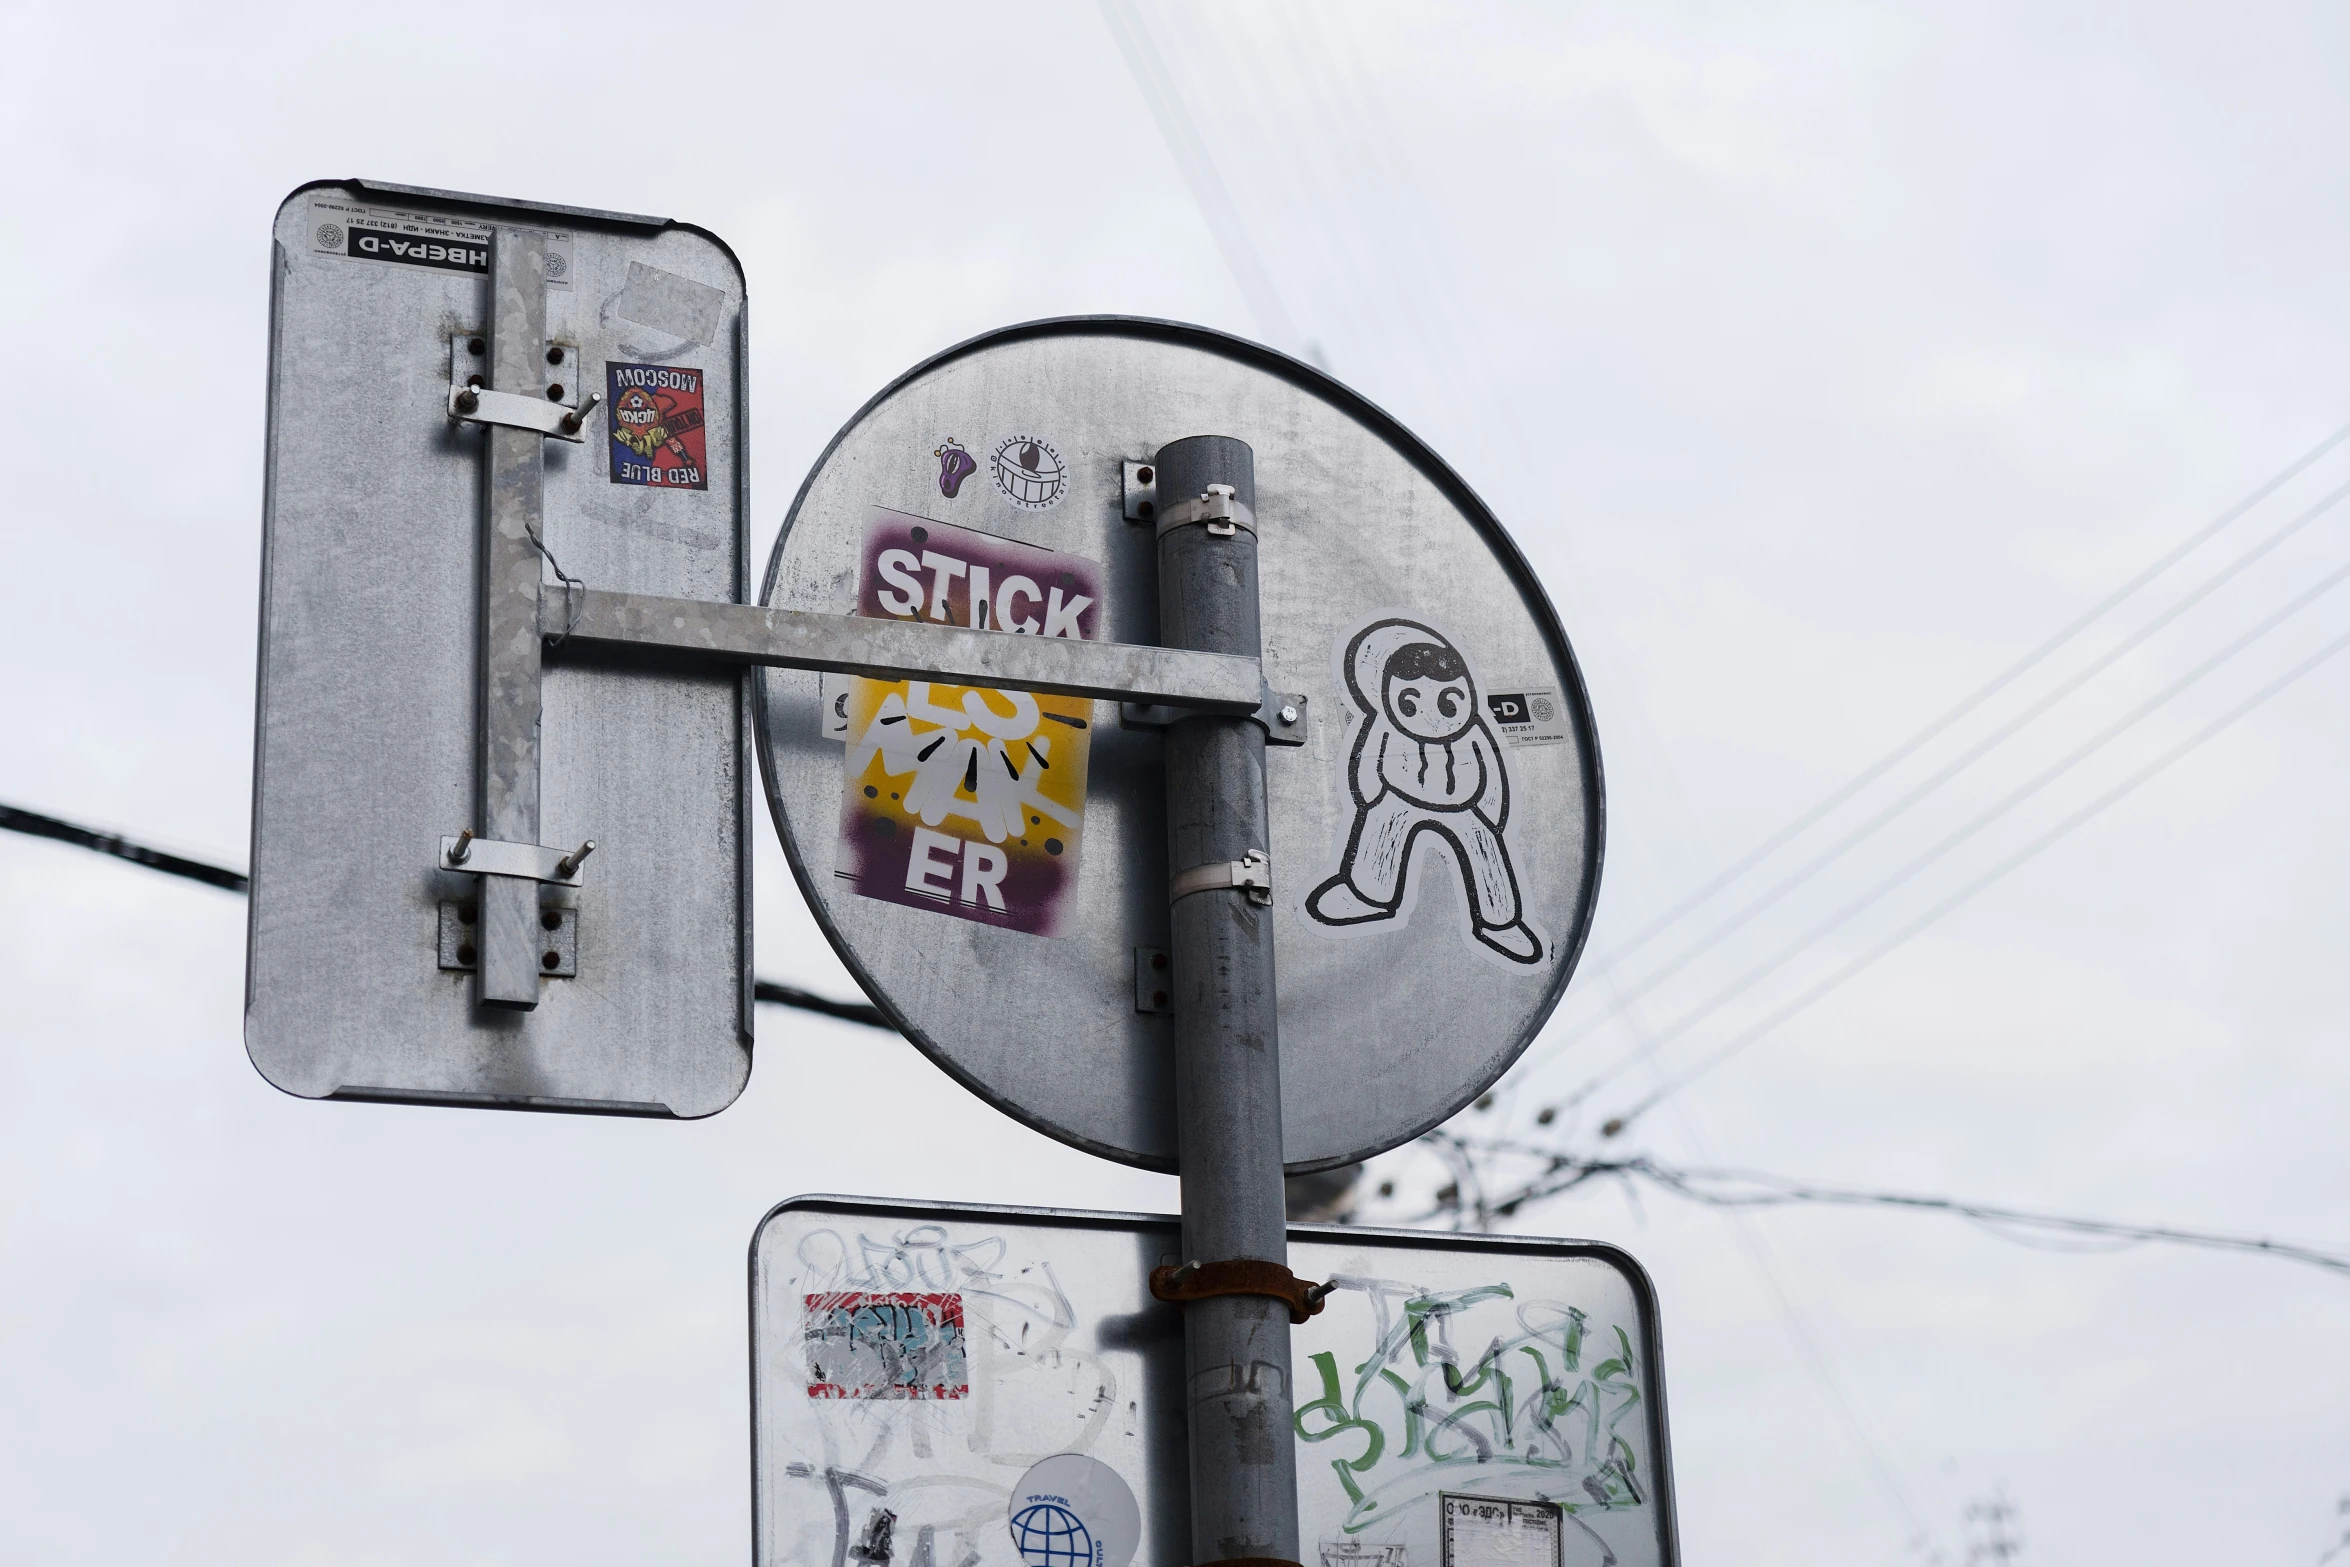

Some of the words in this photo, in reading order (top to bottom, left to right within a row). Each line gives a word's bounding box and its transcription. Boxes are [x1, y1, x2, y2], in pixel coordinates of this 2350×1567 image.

[366, 219, 379, 227] 337
[380, 221, 398, 230] (812)
[402, 224, 419, 232] ИДН
[425, 227, 450, 237] ЗНАКИ
[615, 368, 697, 393] MOSCOW
[619, 408, 656, 424] ЦСКА
[877, 548, 1094, 640] STICK
[1493, 701, 1519, 717] -D
[904, 826, 1009, 915] ER
[1026, 1494, 1071, 1508] TRAVEL
[1446, 1502, 1470, 1516] ОО
[1536, 1509, 1555, 1520] 2020
